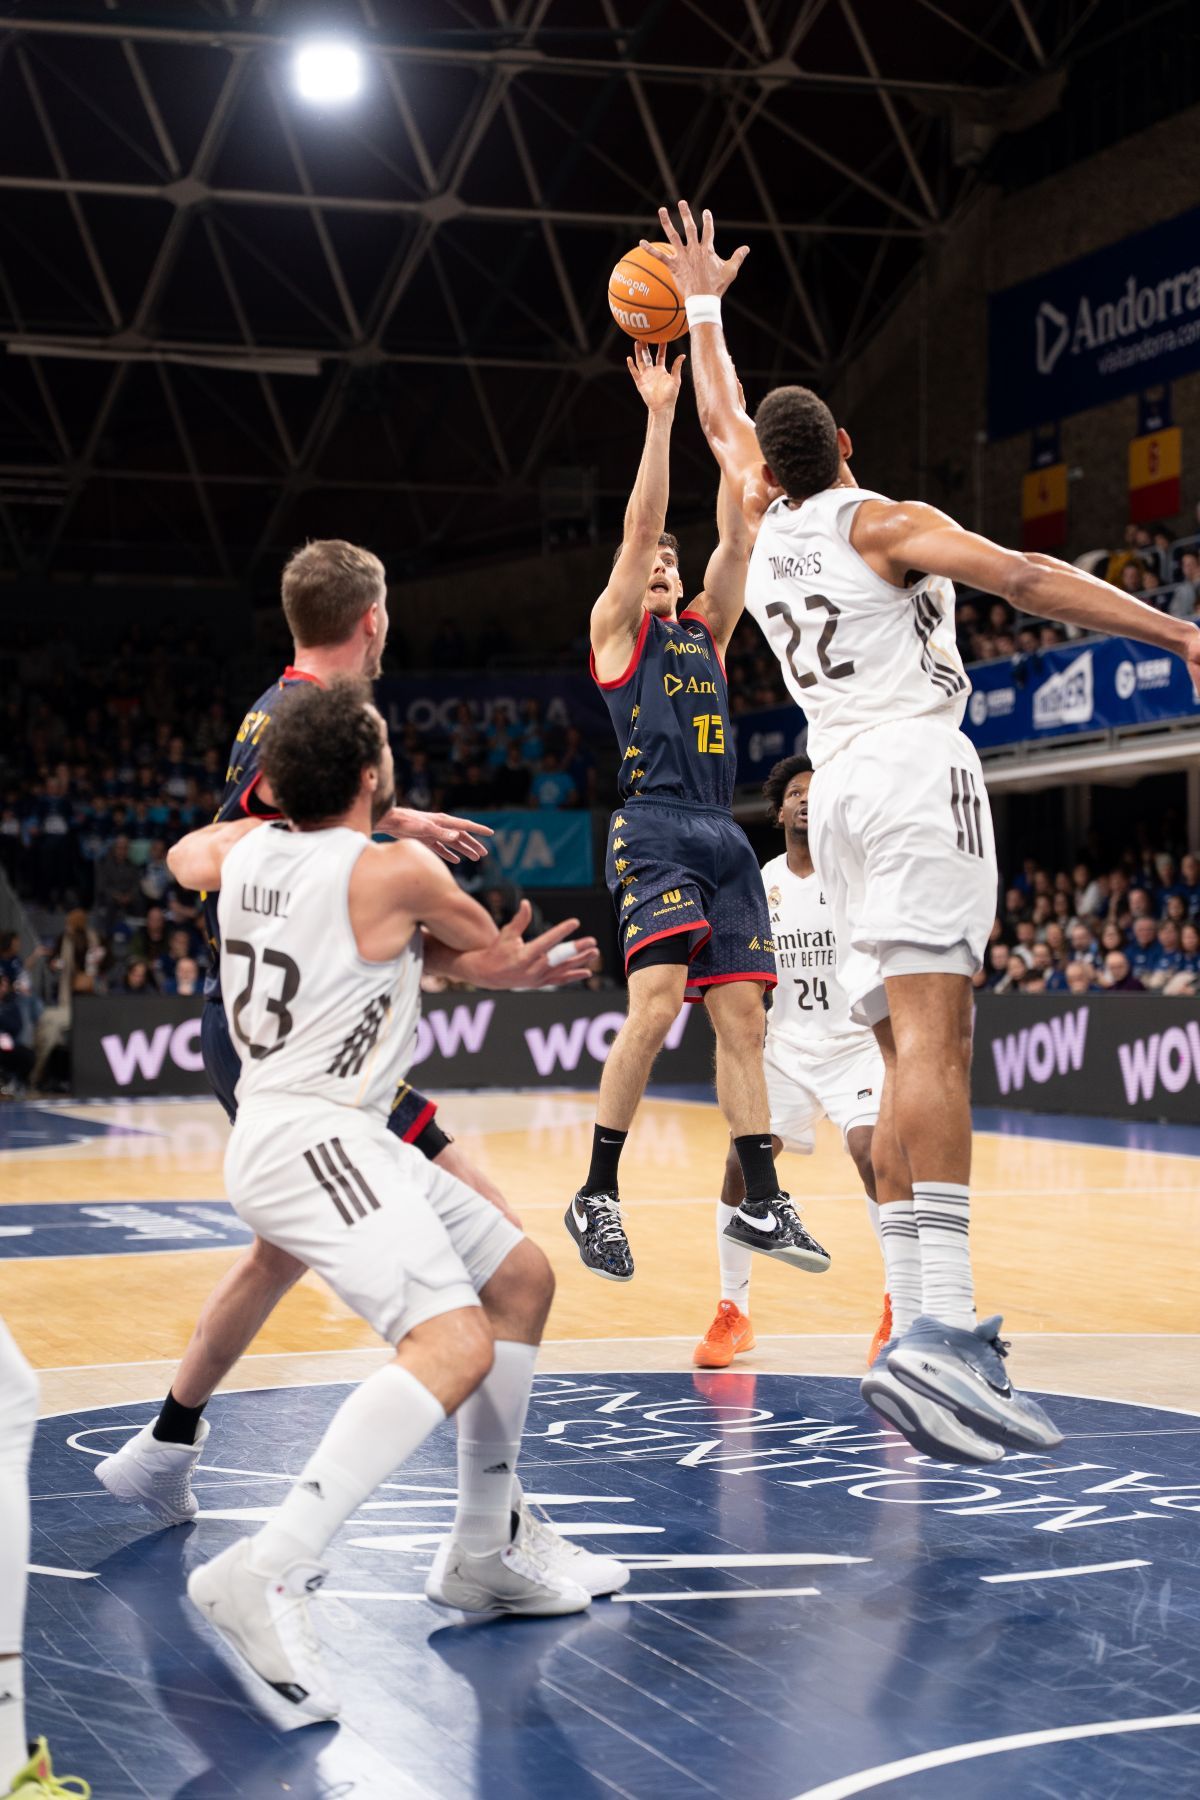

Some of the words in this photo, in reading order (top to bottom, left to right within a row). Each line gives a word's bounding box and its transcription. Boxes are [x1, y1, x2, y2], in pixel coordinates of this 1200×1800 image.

[1070, 264, 1200, 357] Andorra
[764, 593, 855, 690] 22
[692, 713, 725, 755] 13
[779, 953, 796, 969] FLY
[801, 950, 837, 968] BETTE
[793, 977, 830, 1011] 24
[224, 938, 302, 1061] 23
[101, 1018, 205, 1086] WO
[991, 1005, 1090, 1096] WOW
